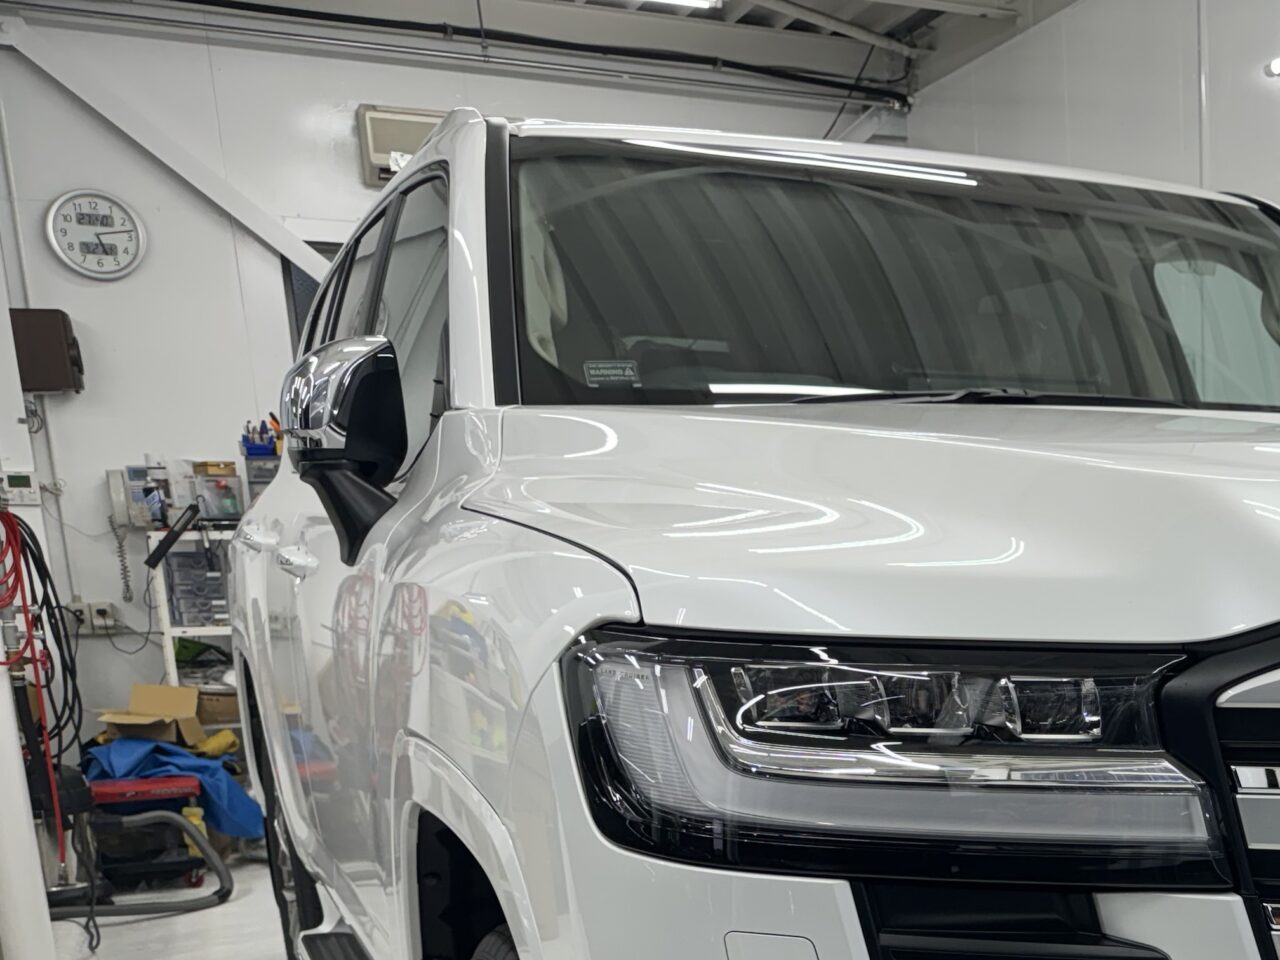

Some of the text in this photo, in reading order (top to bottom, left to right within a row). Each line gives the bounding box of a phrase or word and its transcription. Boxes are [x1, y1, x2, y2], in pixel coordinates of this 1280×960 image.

[73, 202, 82, 212] 11
[88, 201, 98, 211] 12
[62, 213, 72, 223] 10
[120, 217, 127, 226] 2
[60, 228, 67, 237] 9
[127, 232, 133, 242] 3
[67, 242, 75, 251] 8
[122, 247, 129, 256] 4
[81, 254, 87, 264] 7
[97, 259, 104, 268] 6
[113, 256, 120, 266] 5
